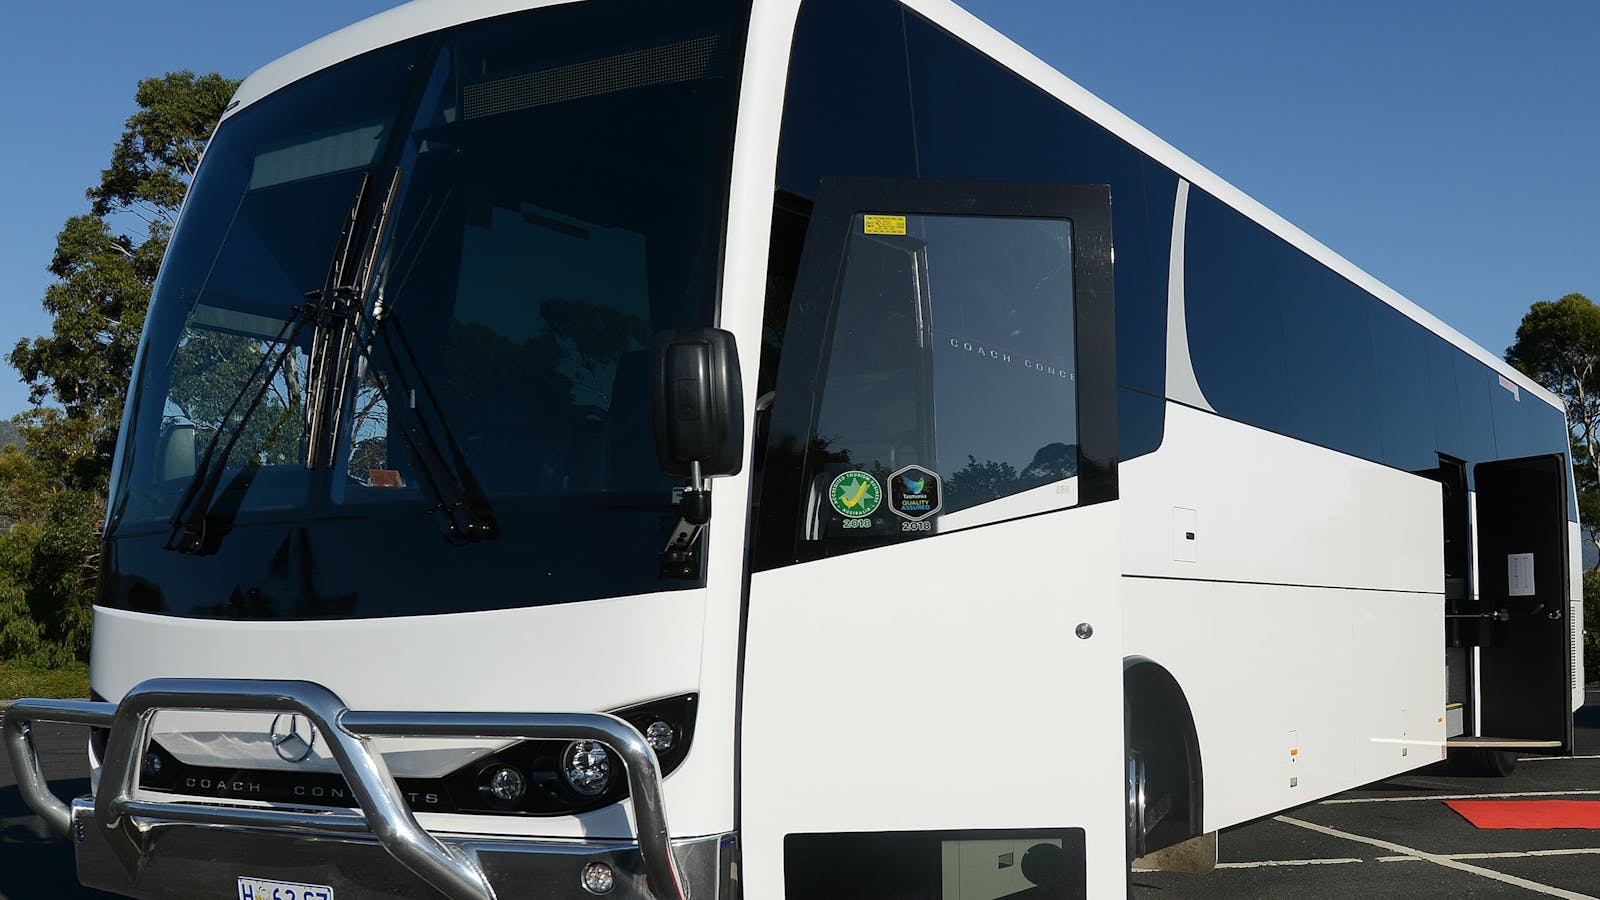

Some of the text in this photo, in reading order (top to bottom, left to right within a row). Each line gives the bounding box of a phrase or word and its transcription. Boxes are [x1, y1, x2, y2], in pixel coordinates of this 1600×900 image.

[949, 338, 1012, 363] COACH
[843, 519, 872, 528] 2018
[902, 521, 931, 531] 2018
[186, 777, 439, 804] COACH CONTS
